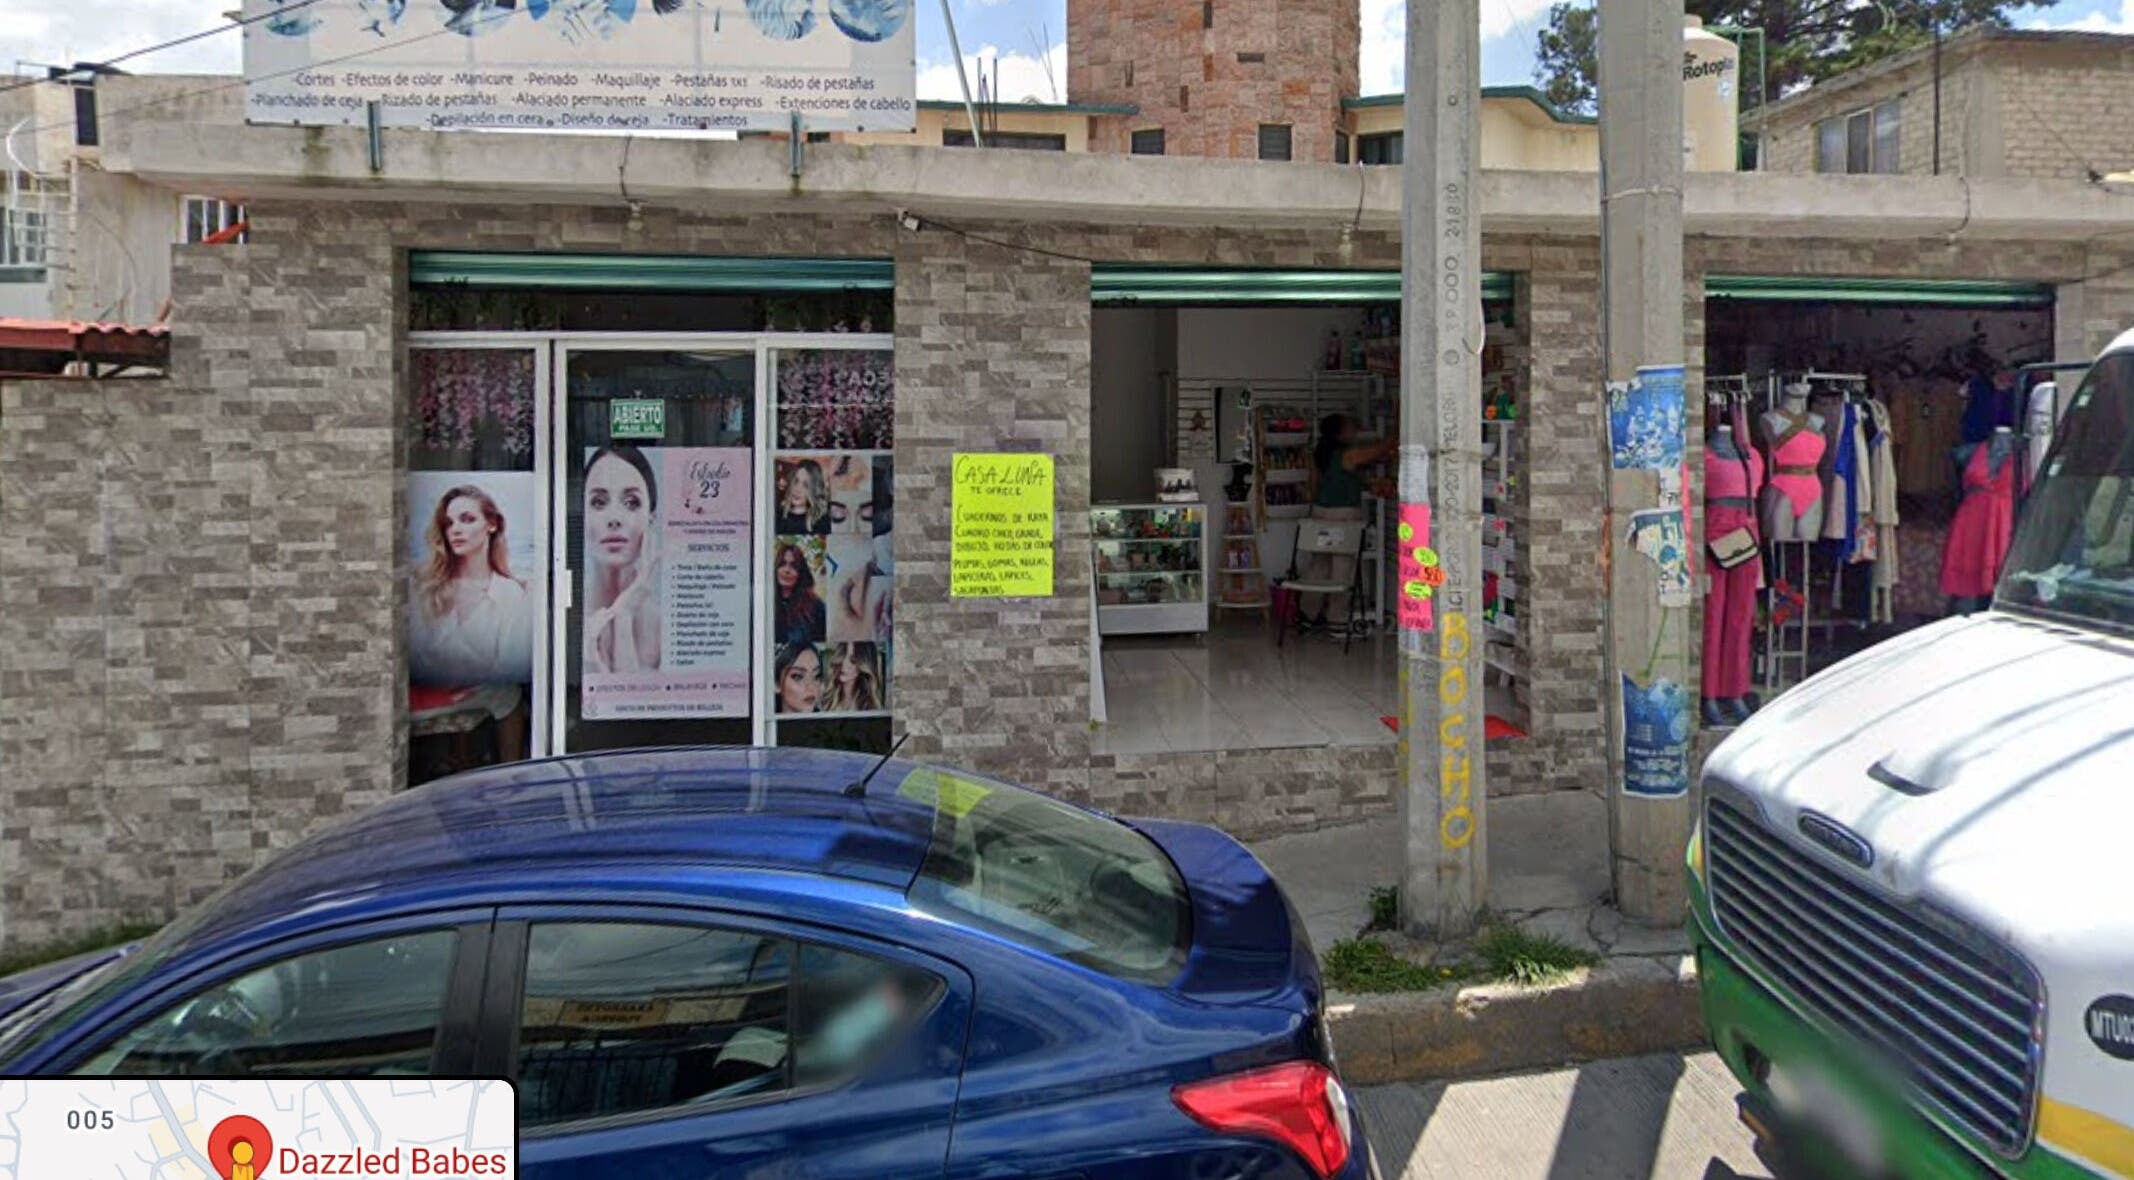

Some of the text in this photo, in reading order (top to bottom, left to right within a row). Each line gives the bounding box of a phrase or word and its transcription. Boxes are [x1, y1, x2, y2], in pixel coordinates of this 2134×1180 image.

[394, 72, 409, 86] de
[412, 72, 443, 86] color
[807, 75, 821, 90] de
[322, 94, 336, 107] de
[425, 94, 440, 107] de
[572, 95, 646, 109] permanente
[719, 95, 762, 109] express
[852, 97, 867, 111] de
[870, 97, 911, 111] cabello
[500, 113, 514, 124] en
[518, 113, 544, 125] cera
[613, 405, 661, 424] ABIERTO
[955, 455, 997, 485] CASA
[699, 480, 721, 499] 23
[970, 486, 981, 495] TE
